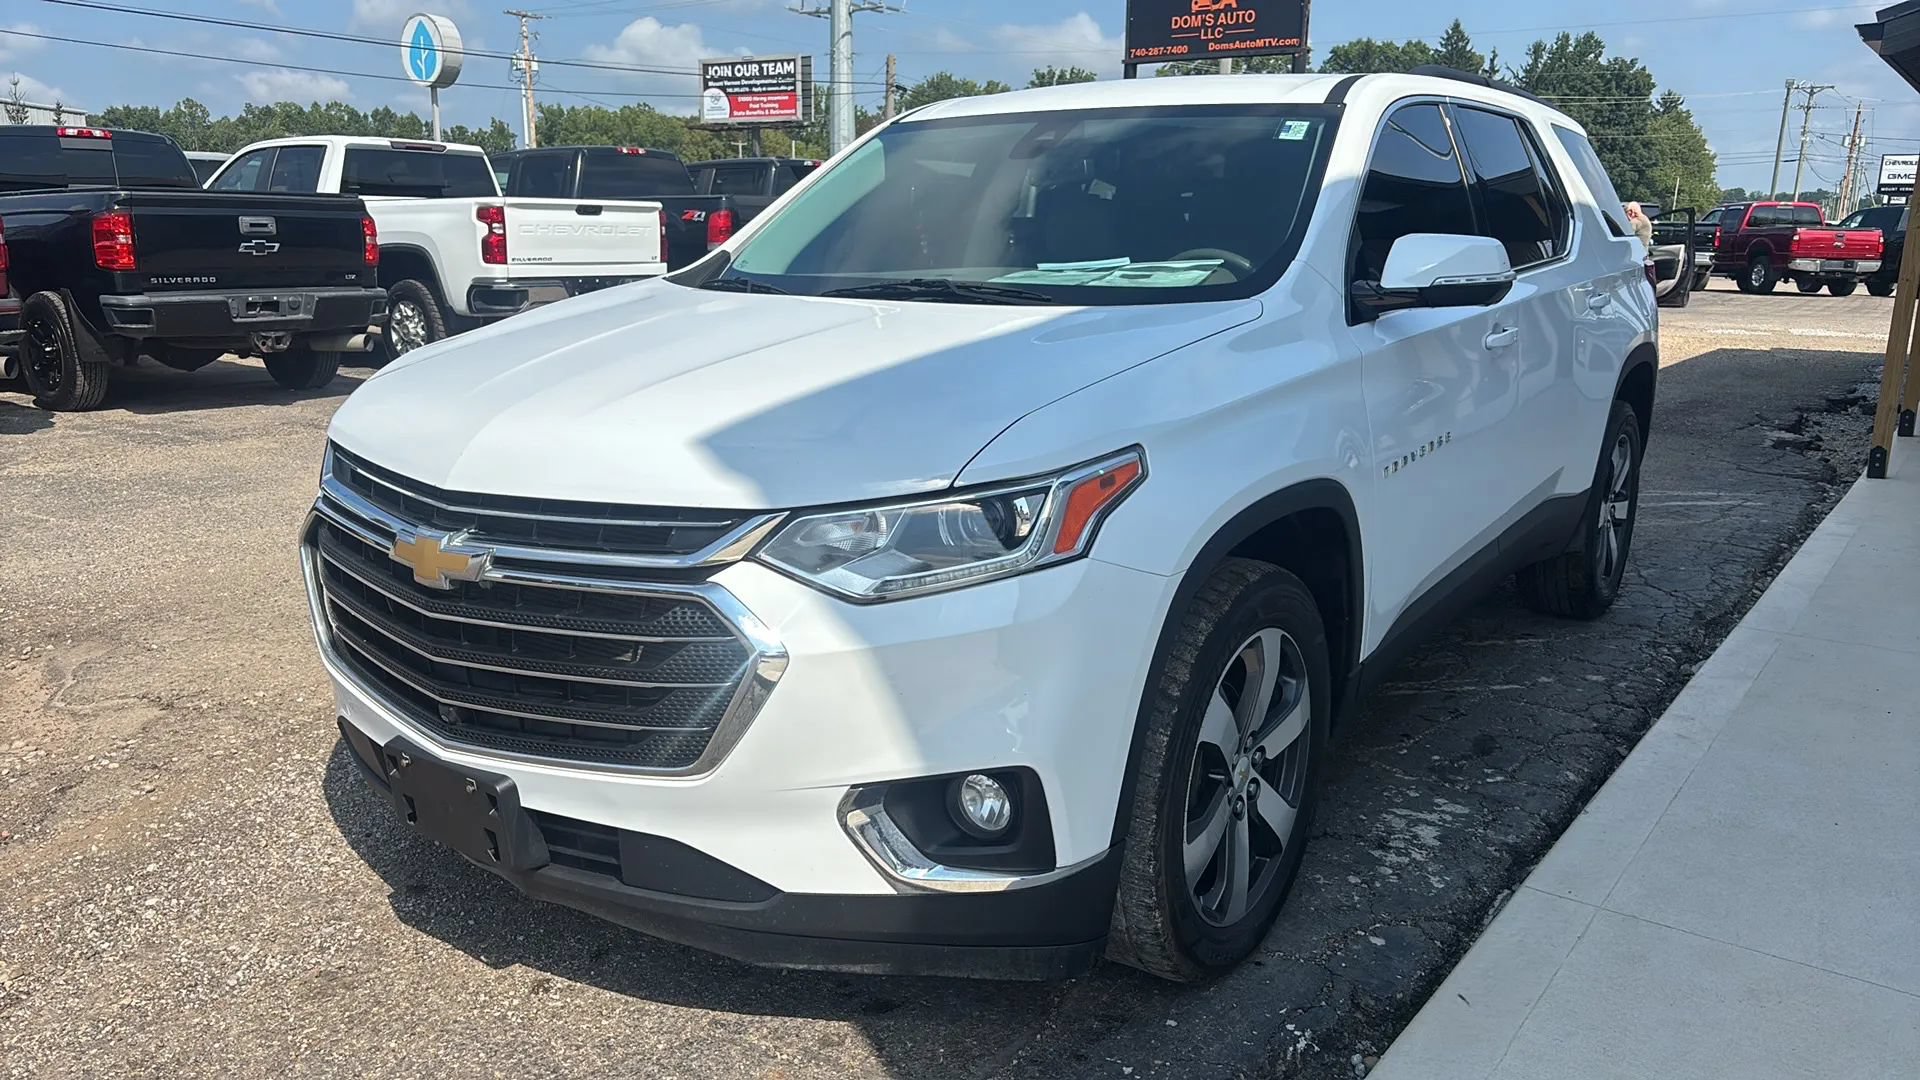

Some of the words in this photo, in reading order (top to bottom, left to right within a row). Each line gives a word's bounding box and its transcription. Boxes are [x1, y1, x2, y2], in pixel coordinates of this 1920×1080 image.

[1171, 13, 1214, 29] DOM'S
[1217, 10, 1256, 25] AUTO
[1200, 28, 1224, 40] LLC
[1130, 45, 1188, 58] 740-287-7400
[1208, 38, 1300, 51] DomsAutoMTV.com
[705, 65, 732, 79] JOIN
[734, 63, 760, 77] OUR
[761, 61, 795, 76] TEAM
[518, 223, 652, 237] CHEVROLET
[150, 276, 217, 285] SILVERADO
